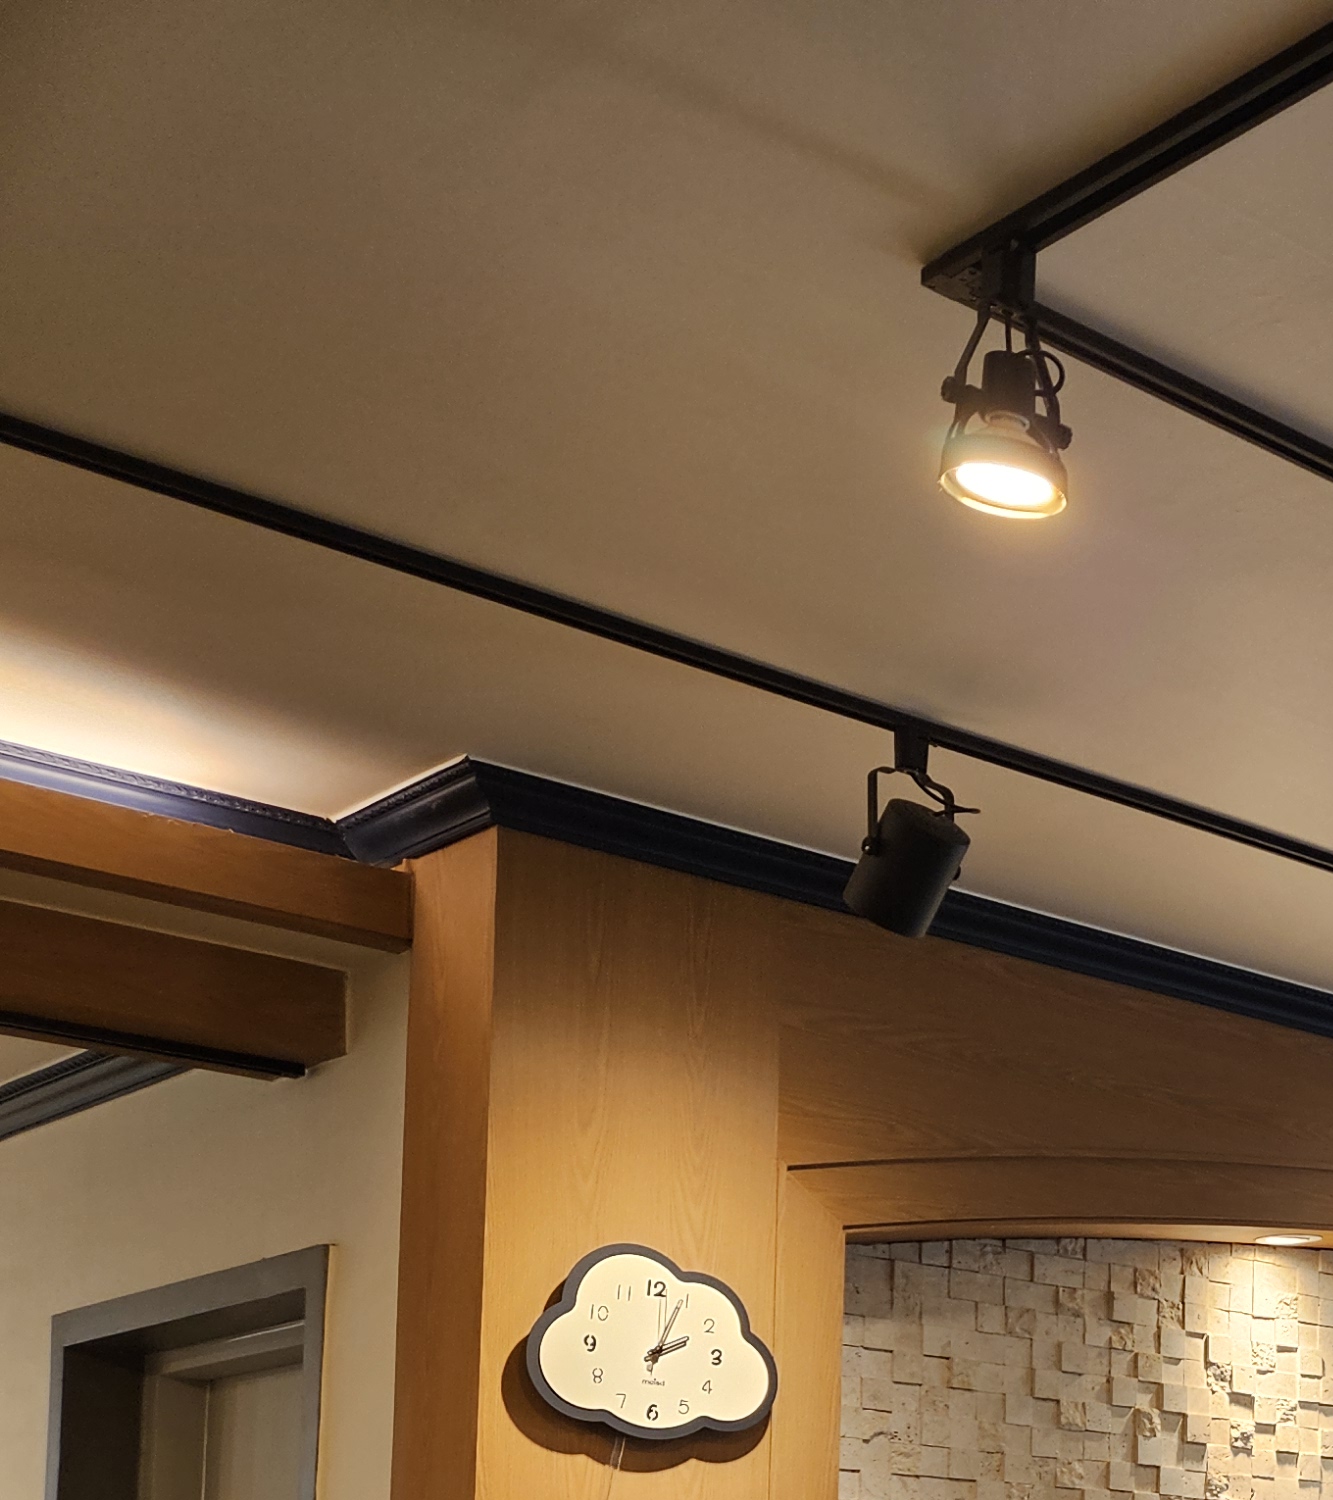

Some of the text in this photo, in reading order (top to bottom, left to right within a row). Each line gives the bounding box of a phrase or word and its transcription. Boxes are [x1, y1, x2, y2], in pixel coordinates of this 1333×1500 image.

[617, 1284, 632, 1301] 11
[646, 1279, 667, 1298] 12
[685, 1293, 690, 1309] 1
[590, 1304, 609, 1321] 10
[703, 1318, 715, 1334] 2
[583, 1334, 597, 1352] 9
[710, 1349, 723, 1366] 3
[591, 1367, 604, 1384] 8
[701, 1379, 713, 1395] 4
[615, 1393, 627, 1409] 7
[678, 1399, 690, 1415] 5
[646, 1404, 659, 1421] 6
